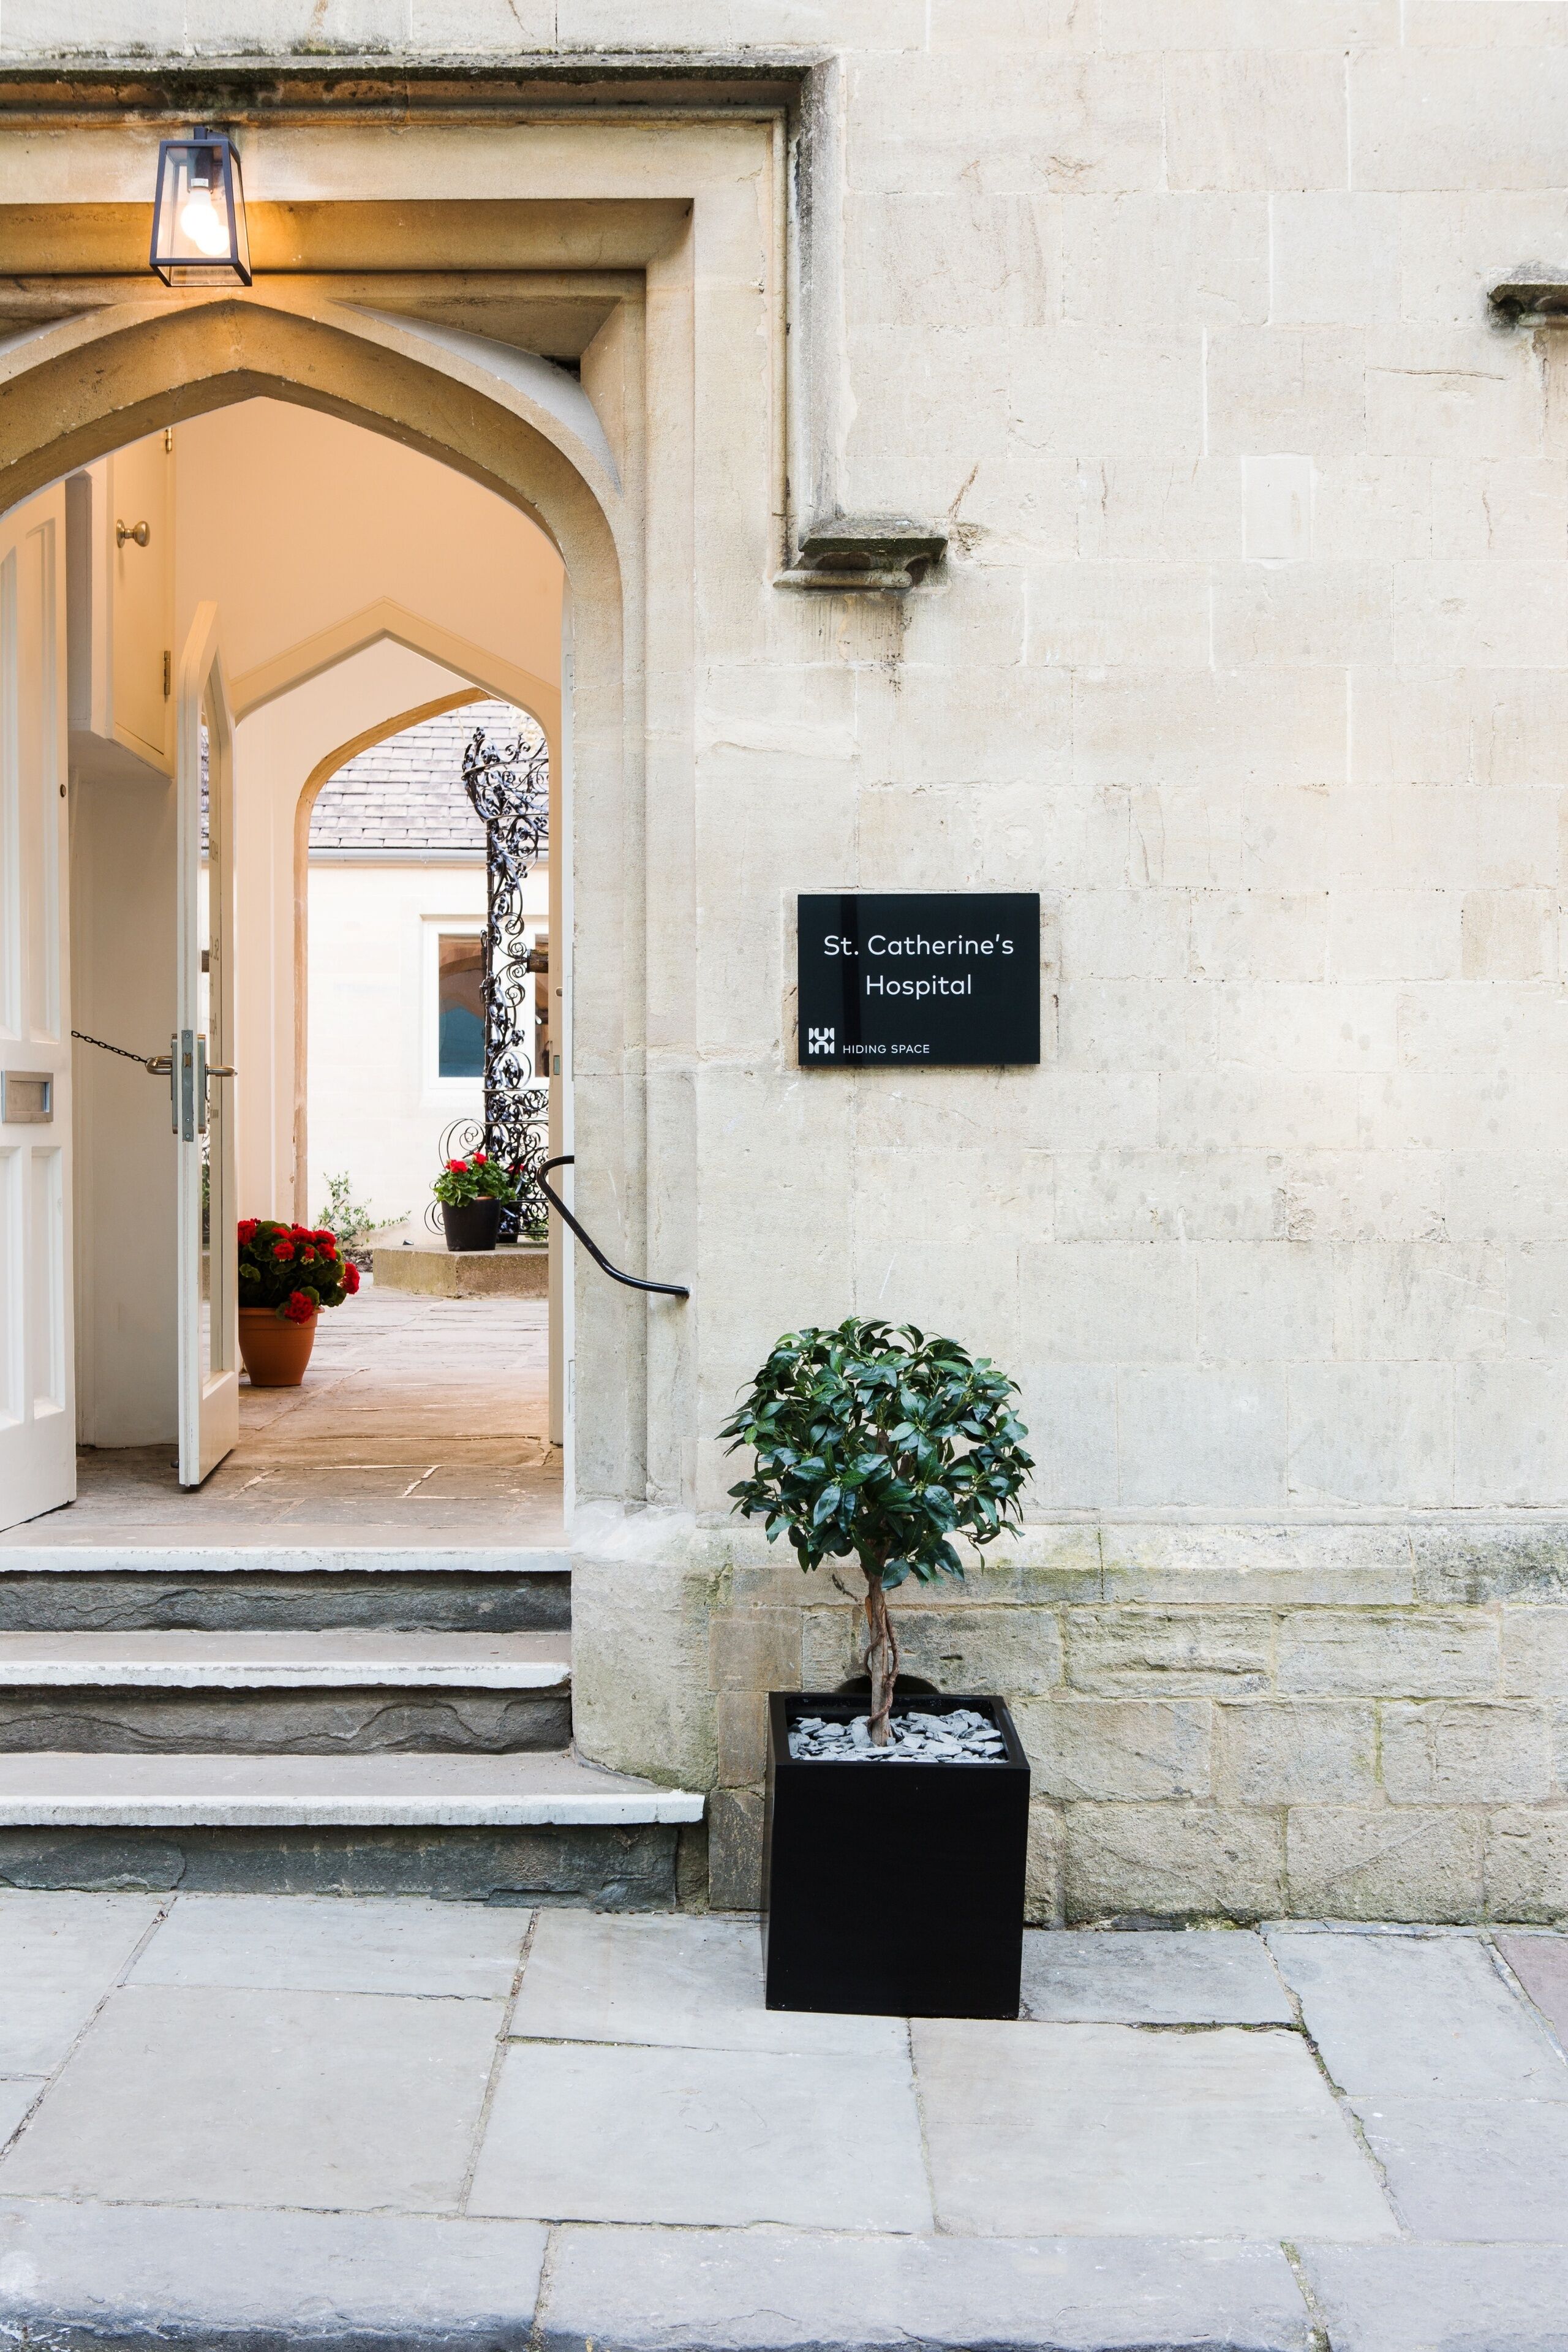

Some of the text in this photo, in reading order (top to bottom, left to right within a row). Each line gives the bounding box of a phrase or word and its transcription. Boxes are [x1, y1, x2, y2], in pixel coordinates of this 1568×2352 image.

[824, 934, 1014, 956] St. Catherine's
[867, 974, 971, 1000] Hospital
[843, 1044, 930, 1054] HIDING SPACE
